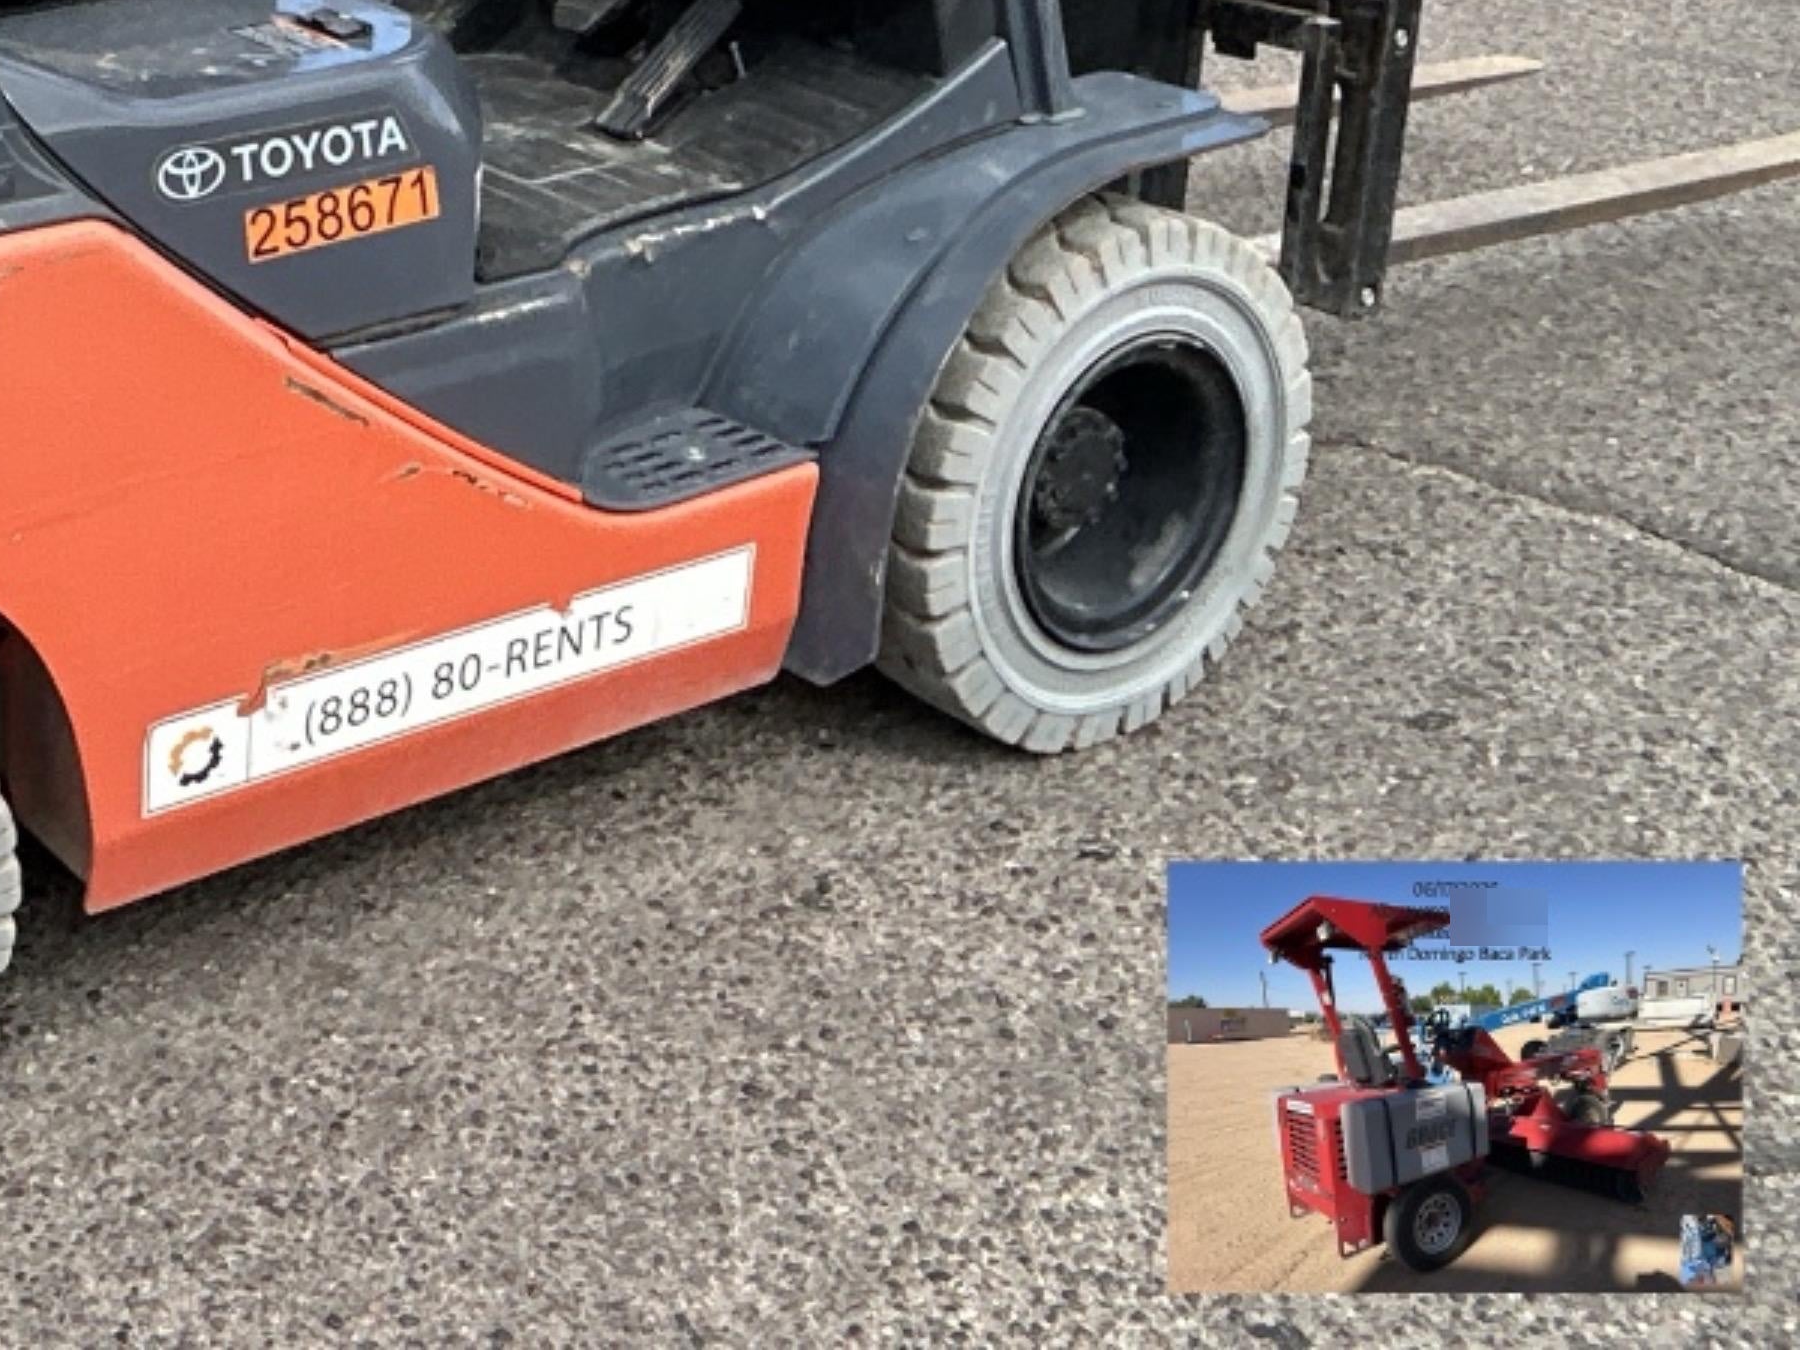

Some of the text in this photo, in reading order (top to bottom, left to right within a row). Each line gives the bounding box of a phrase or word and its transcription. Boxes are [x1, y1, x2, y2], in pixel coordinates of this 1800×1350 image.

[231, 116, 408, 182] TOYOTA
[250, 169, 432, 258] 258671
[304, 605, 634, 745] (888) 80-RENTS
